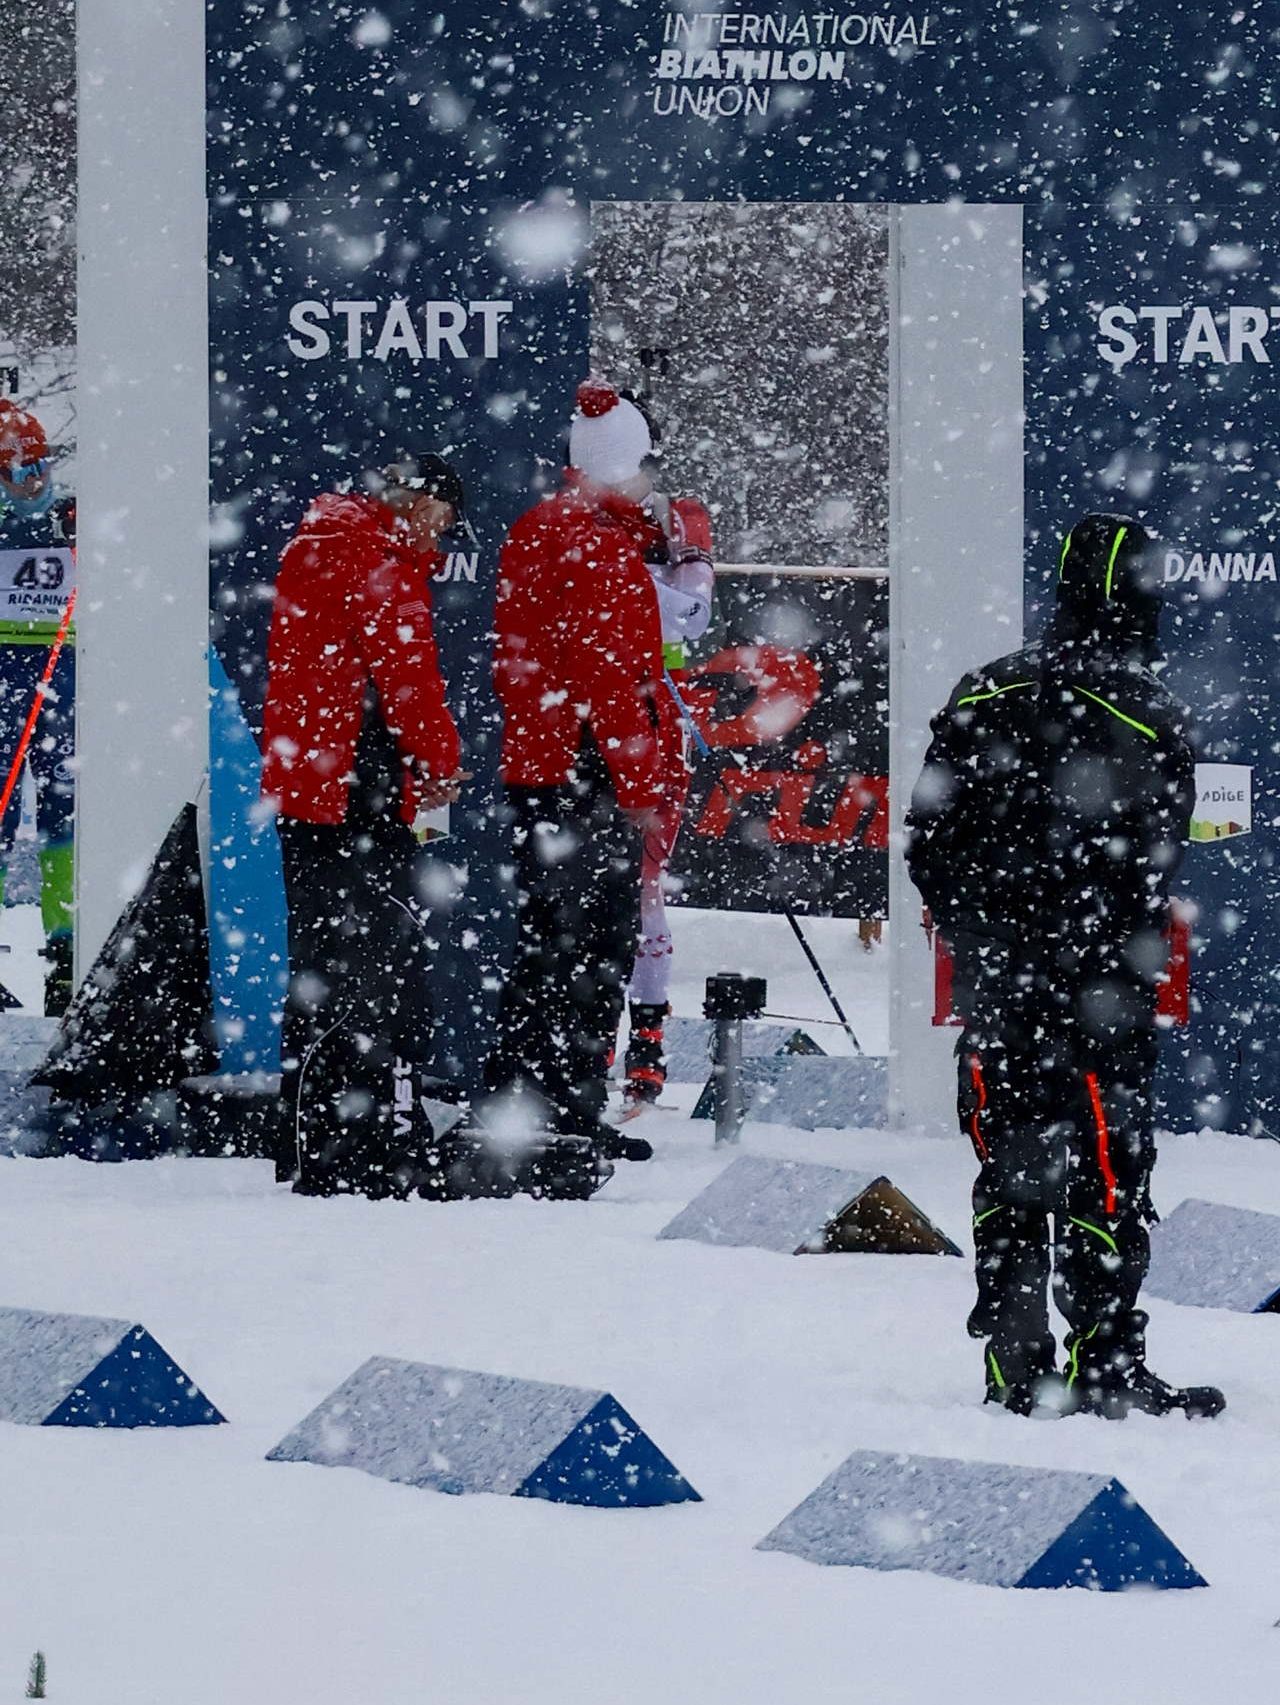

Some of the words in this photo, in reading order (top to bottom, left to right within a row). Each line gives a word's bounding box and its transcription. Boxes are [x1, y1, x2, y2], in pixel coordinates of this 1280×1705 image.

[663, 13, 938, 46] INTERNATIONAL
[657, 50, 846, 81] BIATHLON
[653, 85, 771, 116] UNION
[287, 299, 514, 361] START
[1163, 552, 1278, 582] DANNA
